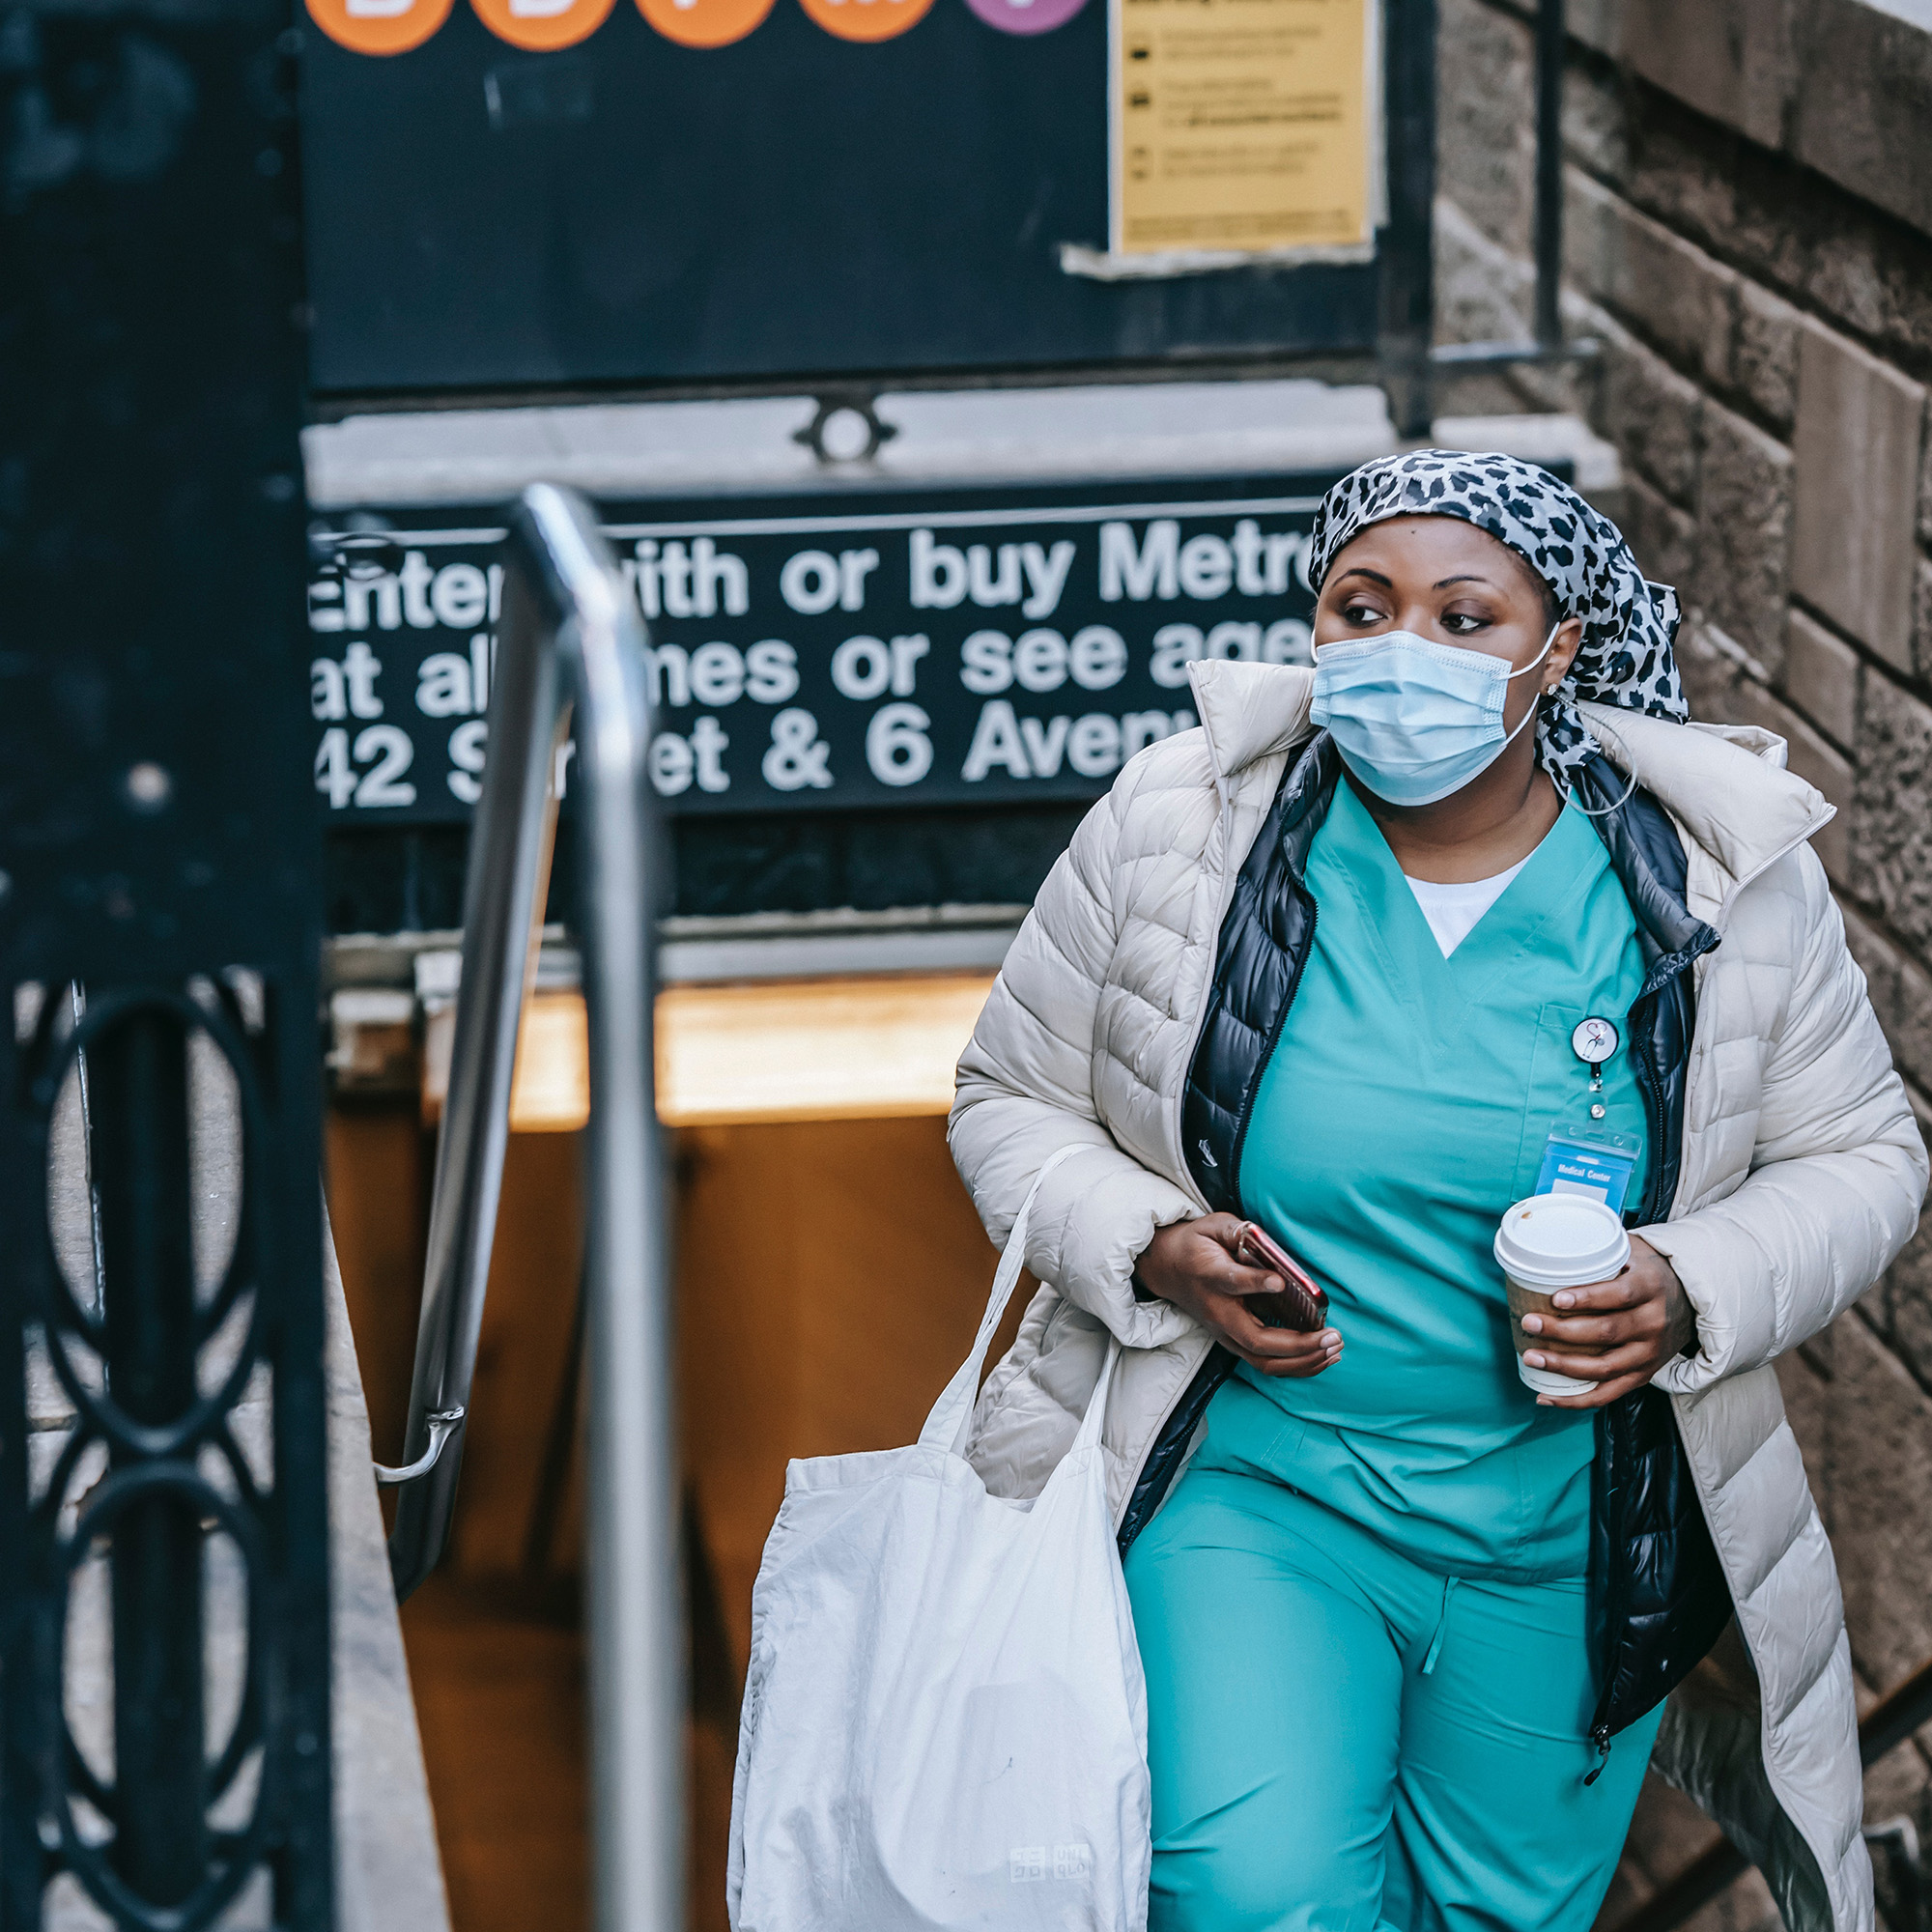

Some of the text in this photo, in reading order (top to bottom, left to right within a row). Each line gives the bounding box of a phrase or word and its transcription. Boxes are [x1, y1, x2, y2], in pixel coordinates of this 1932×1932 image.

[621, 537, 750, 619] ith
[780, 549, 879, 615] or
[908, 528, 1076, 620] buy
[310, 640, 384, 721] at
[414, 633, 498, 718] al
[831, 633, 930, 700] or
[960, 625, 1128, 695] see
[314, 724, 417, 810] 42
[761, 707, 834, 791] &
[866, 702, 934, 786] 6
[961, 699, 1198, 781] Aven
[1557, 1163, 1611, 1182] Medical Center
